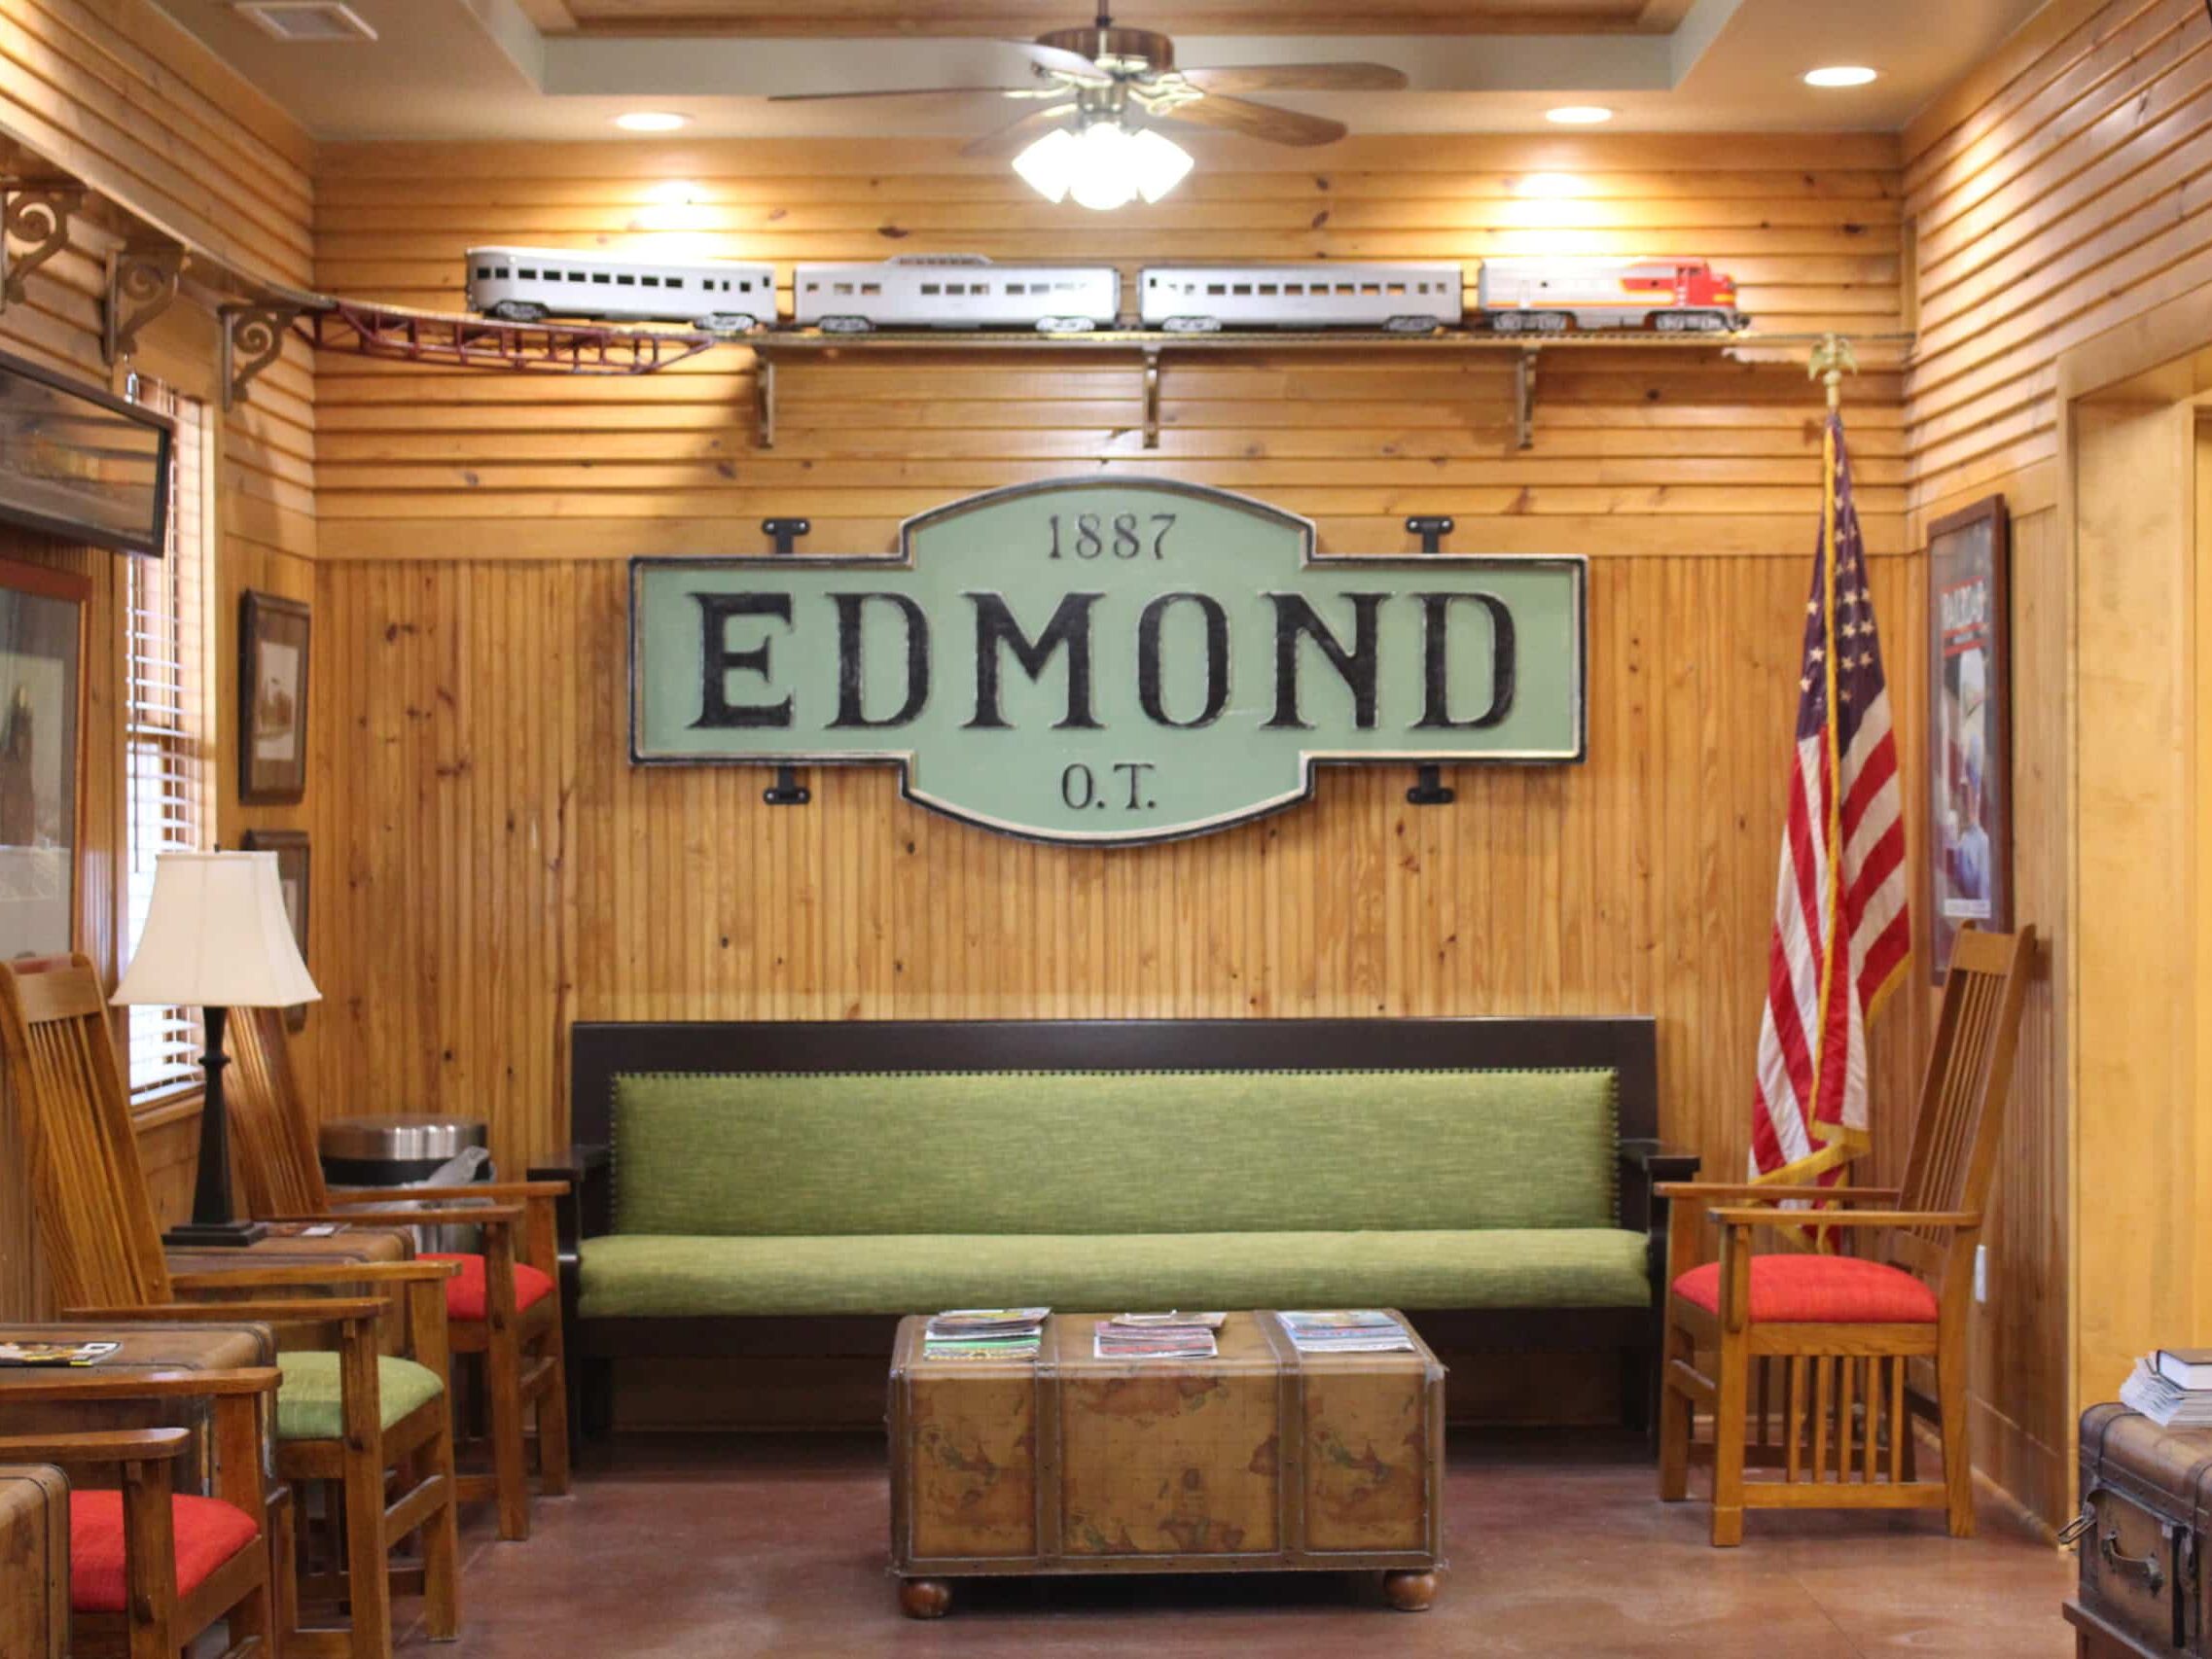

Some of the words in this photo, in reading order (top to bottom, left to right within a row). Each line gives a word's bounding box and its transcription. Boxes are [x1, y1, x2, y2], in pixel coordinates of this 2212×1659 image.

[1049, 513, 1177, 559] 1887
[686, 590, 1517, 731] EDMOND
[1060, 762, 1156, 811] O.T.
